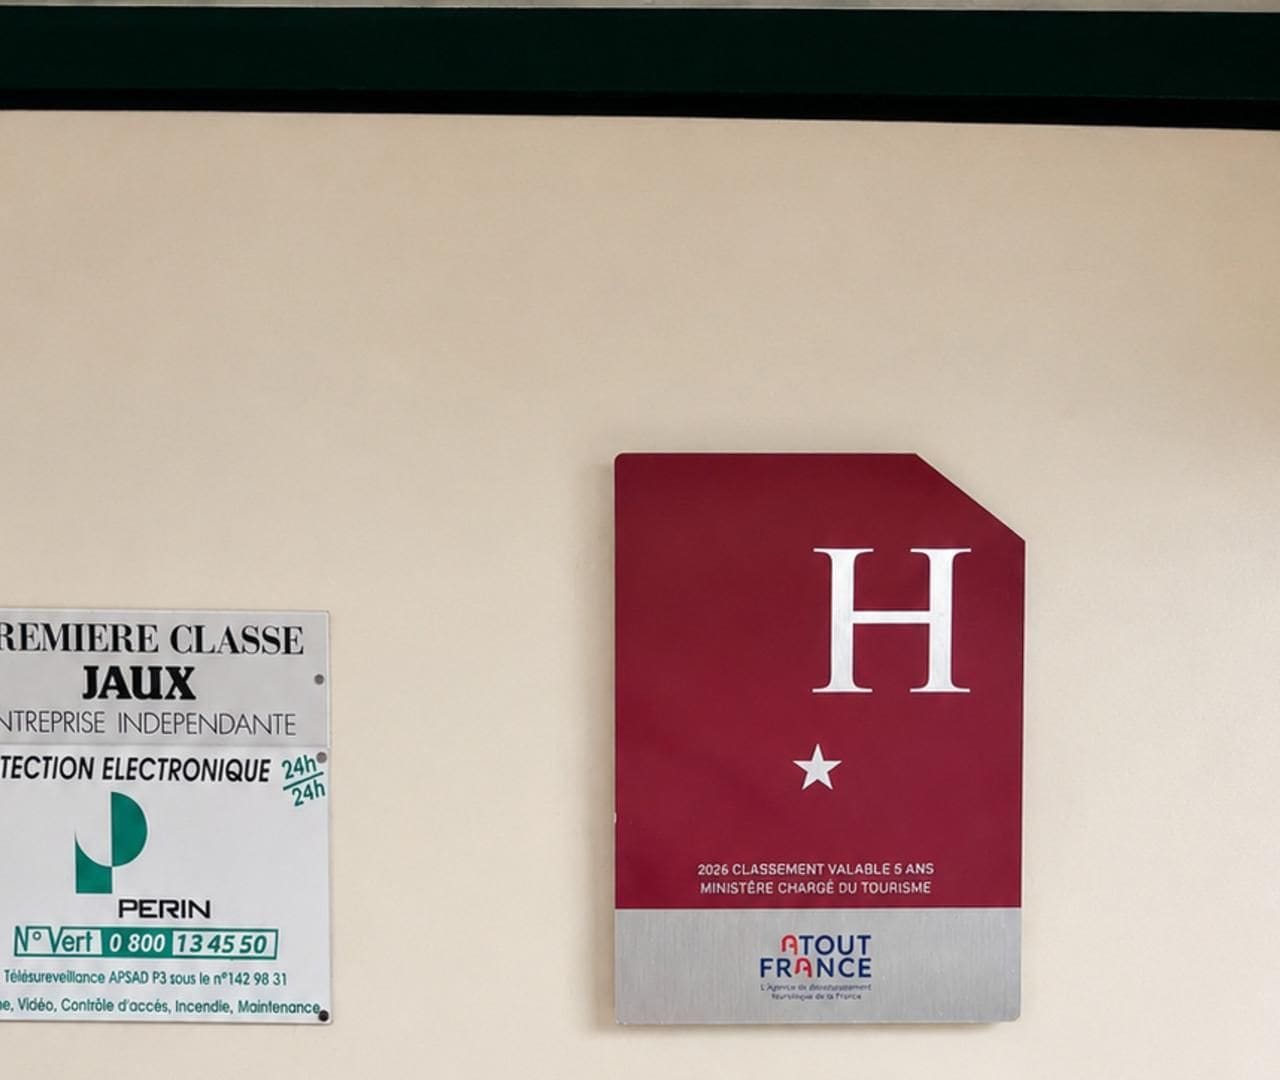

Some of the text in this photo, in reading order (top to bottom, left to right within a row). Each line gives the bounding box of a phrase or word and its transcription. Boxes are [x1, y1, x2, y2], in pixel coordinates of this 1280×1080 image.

[812, 547, 972, 694] H
[170, 624, 305, 656] CLASSE
[81, 665, 197, 701] JAUX
[118, 711, 297, 736] INDEPENDANTE
[102, 757, 272, 783] ELECTRONIQUE
[281, 754, 317, 780] 24h
[291, 779, 326, 807] 24h
[697, 863, 934, 876] 2026 CLASSEMENT VALABLE 5 ANS
[778, 878, 834, 894] CHARGÉ
[839, 881, 857, 894] DU
[862, 881, 932, 894] TOURISME
[118, 899, 212, 919] PERIN
[48, 926, 93, 953] Vert
[109, 933, 122, 953] 0
[127, 933, 166, 953] 800
[781, 935, 872, 956] ATOUT
[109, 970, 149, 985] APSAD
[152, 970, 167, 985] P3
[170, 974, 196, 986] sous
[200, 971, 210, 985] le
[253, 973, 269, 986] 98
[273, 973, 287, 986] 31
[760, 958, 872, 978] FRANCE
[17, 997, 57, 1013] Vidéo,
[61, 997, 115, 1013] Contrôle
[175, 999, 234, 1015] Incendie,
[238, 999, 320, 1015] Maintenance
